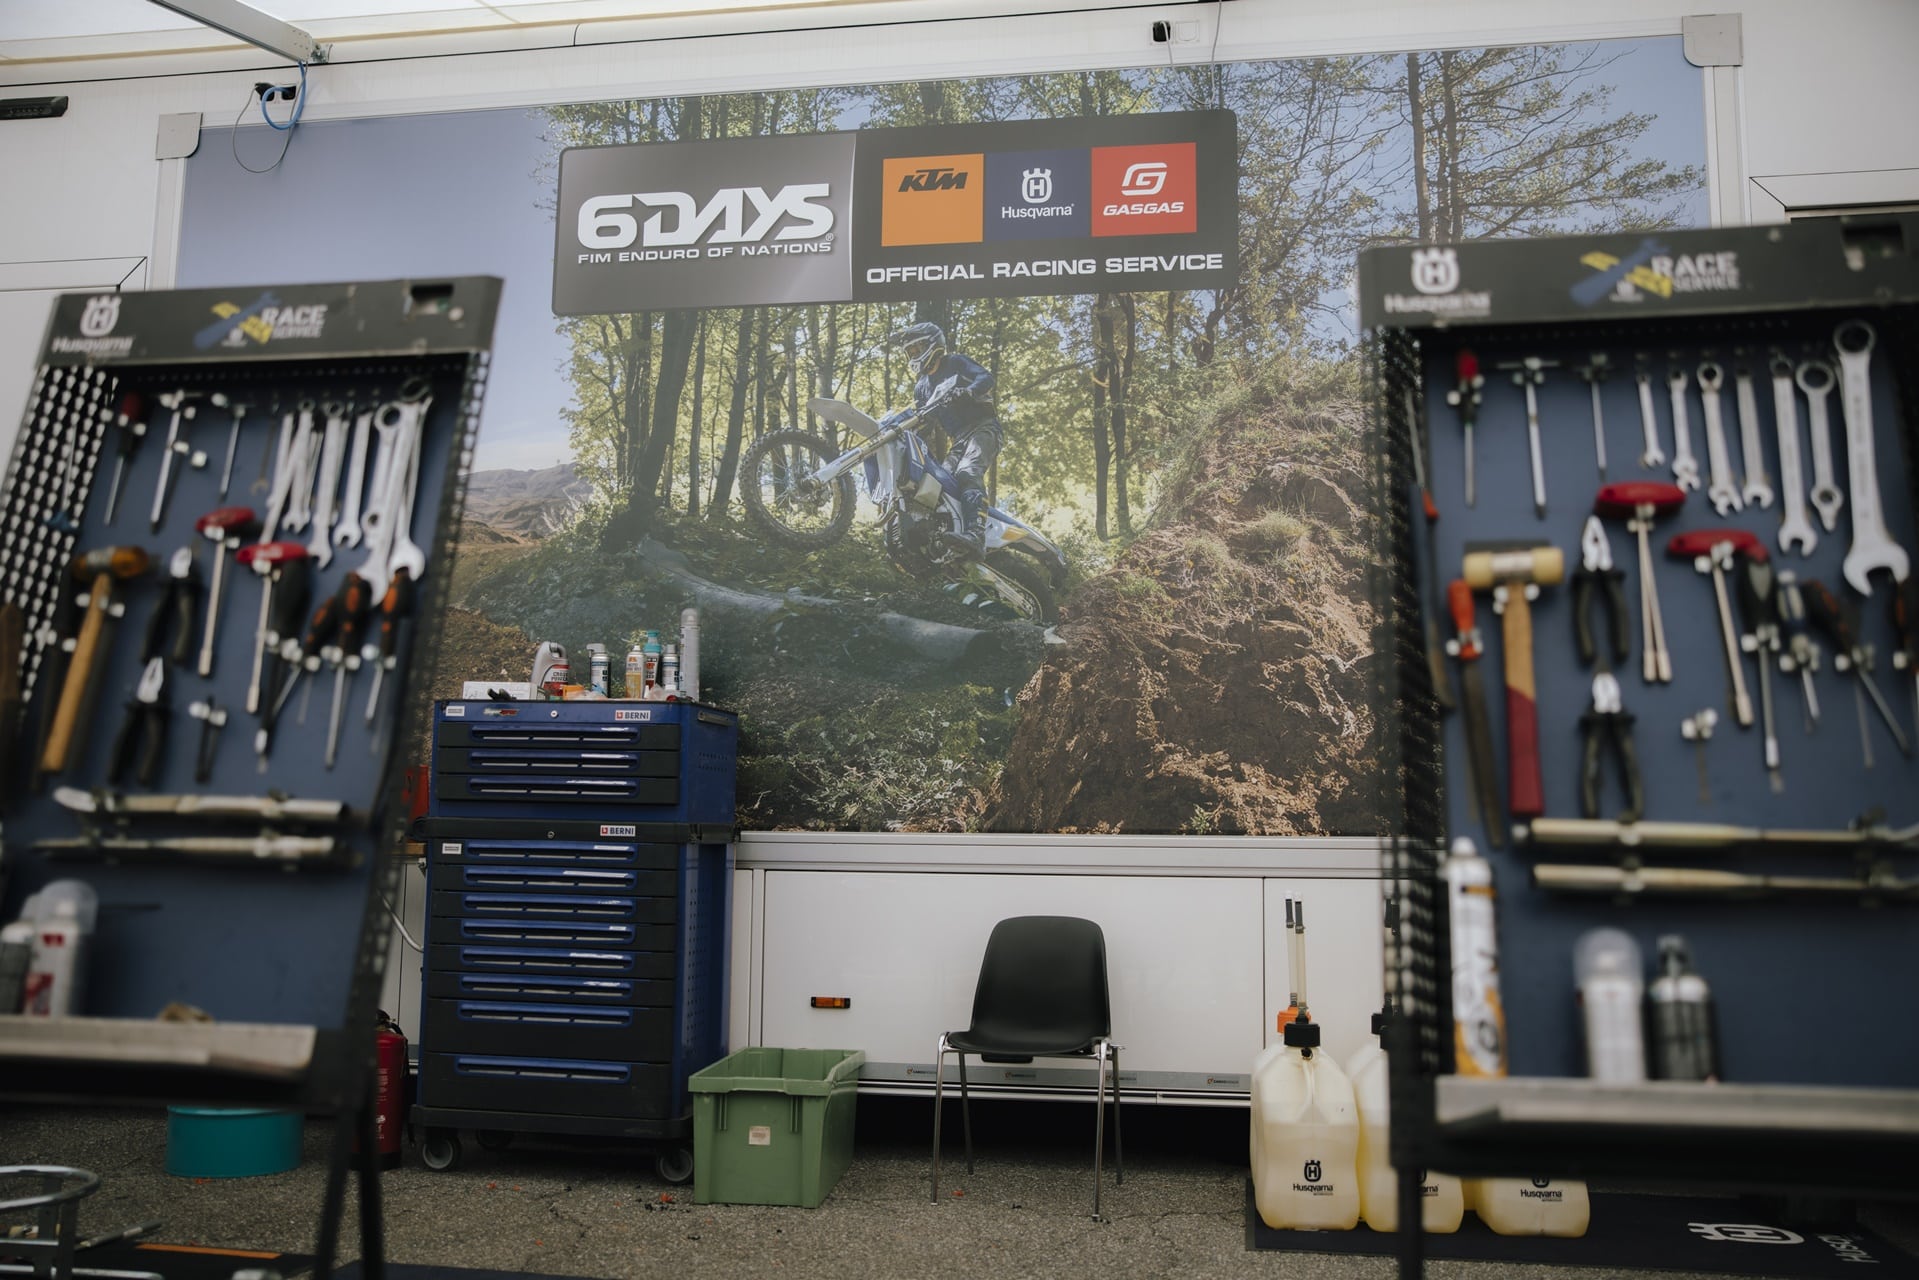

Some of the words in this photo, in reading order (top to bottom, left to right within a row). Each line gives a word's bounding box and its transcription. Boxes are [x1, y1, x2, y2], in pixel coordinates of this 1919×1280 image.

[898, 168, 968, 192] KTM
[577, 183, 834, 249] 6DAYS
[1001, 205, 1073, 219] Husqvarna
[1103, 202, 1185, 216] GASGAS
[578, 253, 611, 264] FIM
[619, 249, 699, 262] ENDURO
[707, 247, 734, 258] OF
[741, 242, 831, 256] NATIONS
[867, 264, 984, 283] OFFICIAL
[993, 259, 1097, 278] RACING
[1105, 254, 1223, 273] SERVICE
[1651, 252, 1737, 277] RACE
[261, 304, 328, 327] RACE
[624, 711, 649, 720] BERNI
[610, 826, 634, 835] BERNI
[1292, 1183, 1333, 1192] Husqvarna
